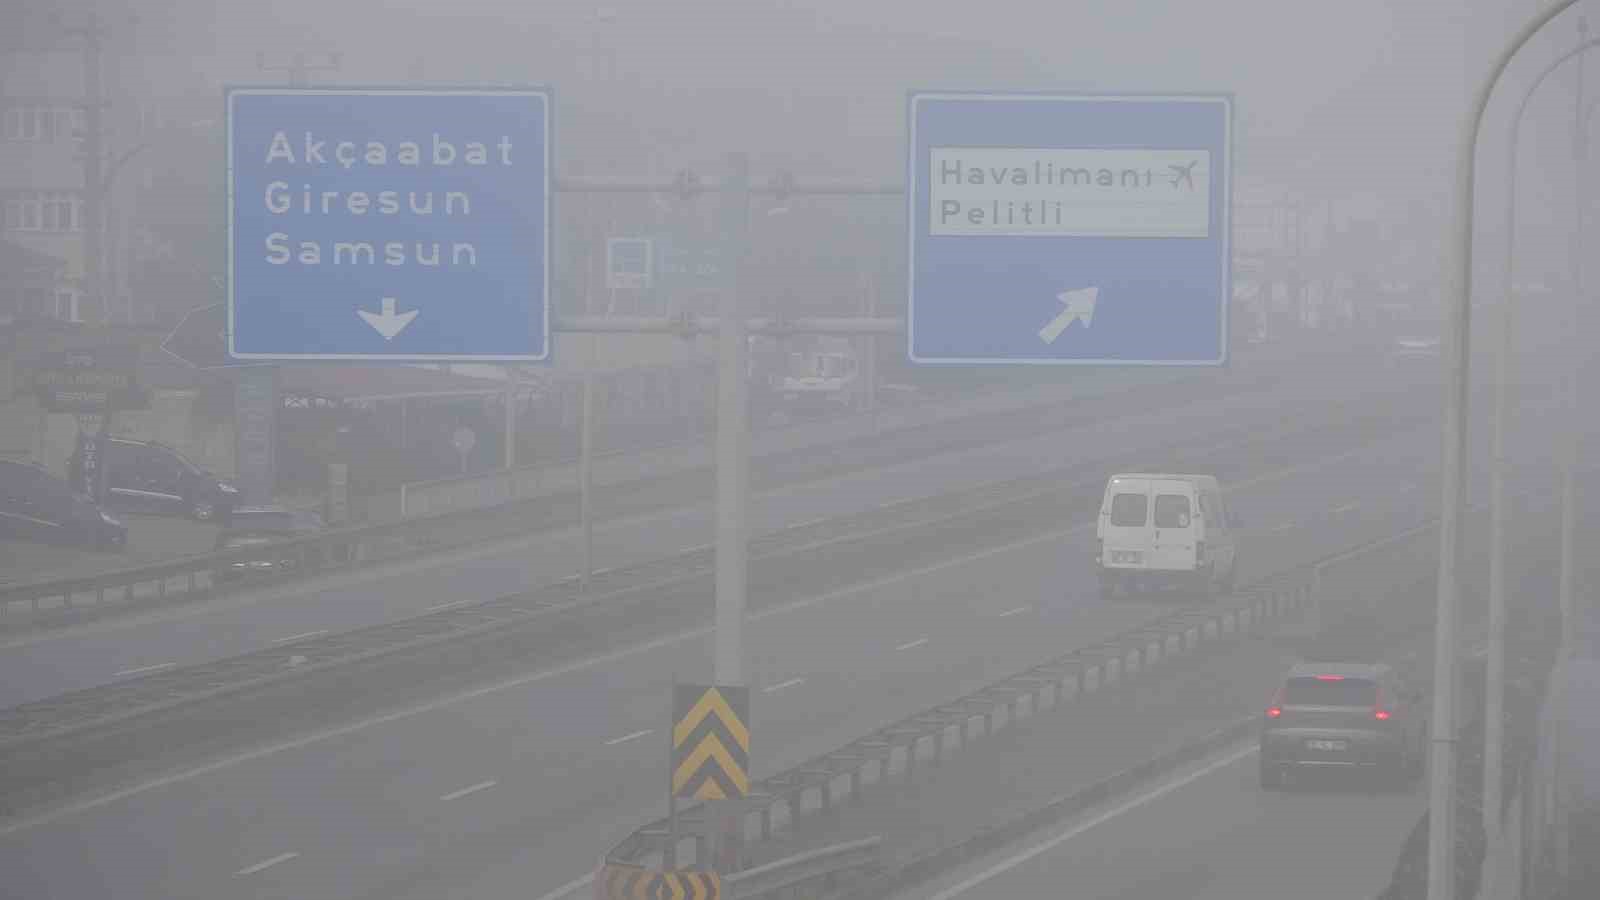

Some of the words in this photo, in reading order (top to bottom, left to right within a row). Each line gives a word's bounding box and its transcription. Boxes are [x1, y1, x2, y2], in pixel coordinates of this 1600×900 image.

[265, 131, 513, 168] Akçaabat
[941, 159, 1152, 187] Havalimanı
[264, 181, 470, 214] Giresun
[941, 199, 1062, 225] Pelitli
[265, 232, 477, 265] Samsun
